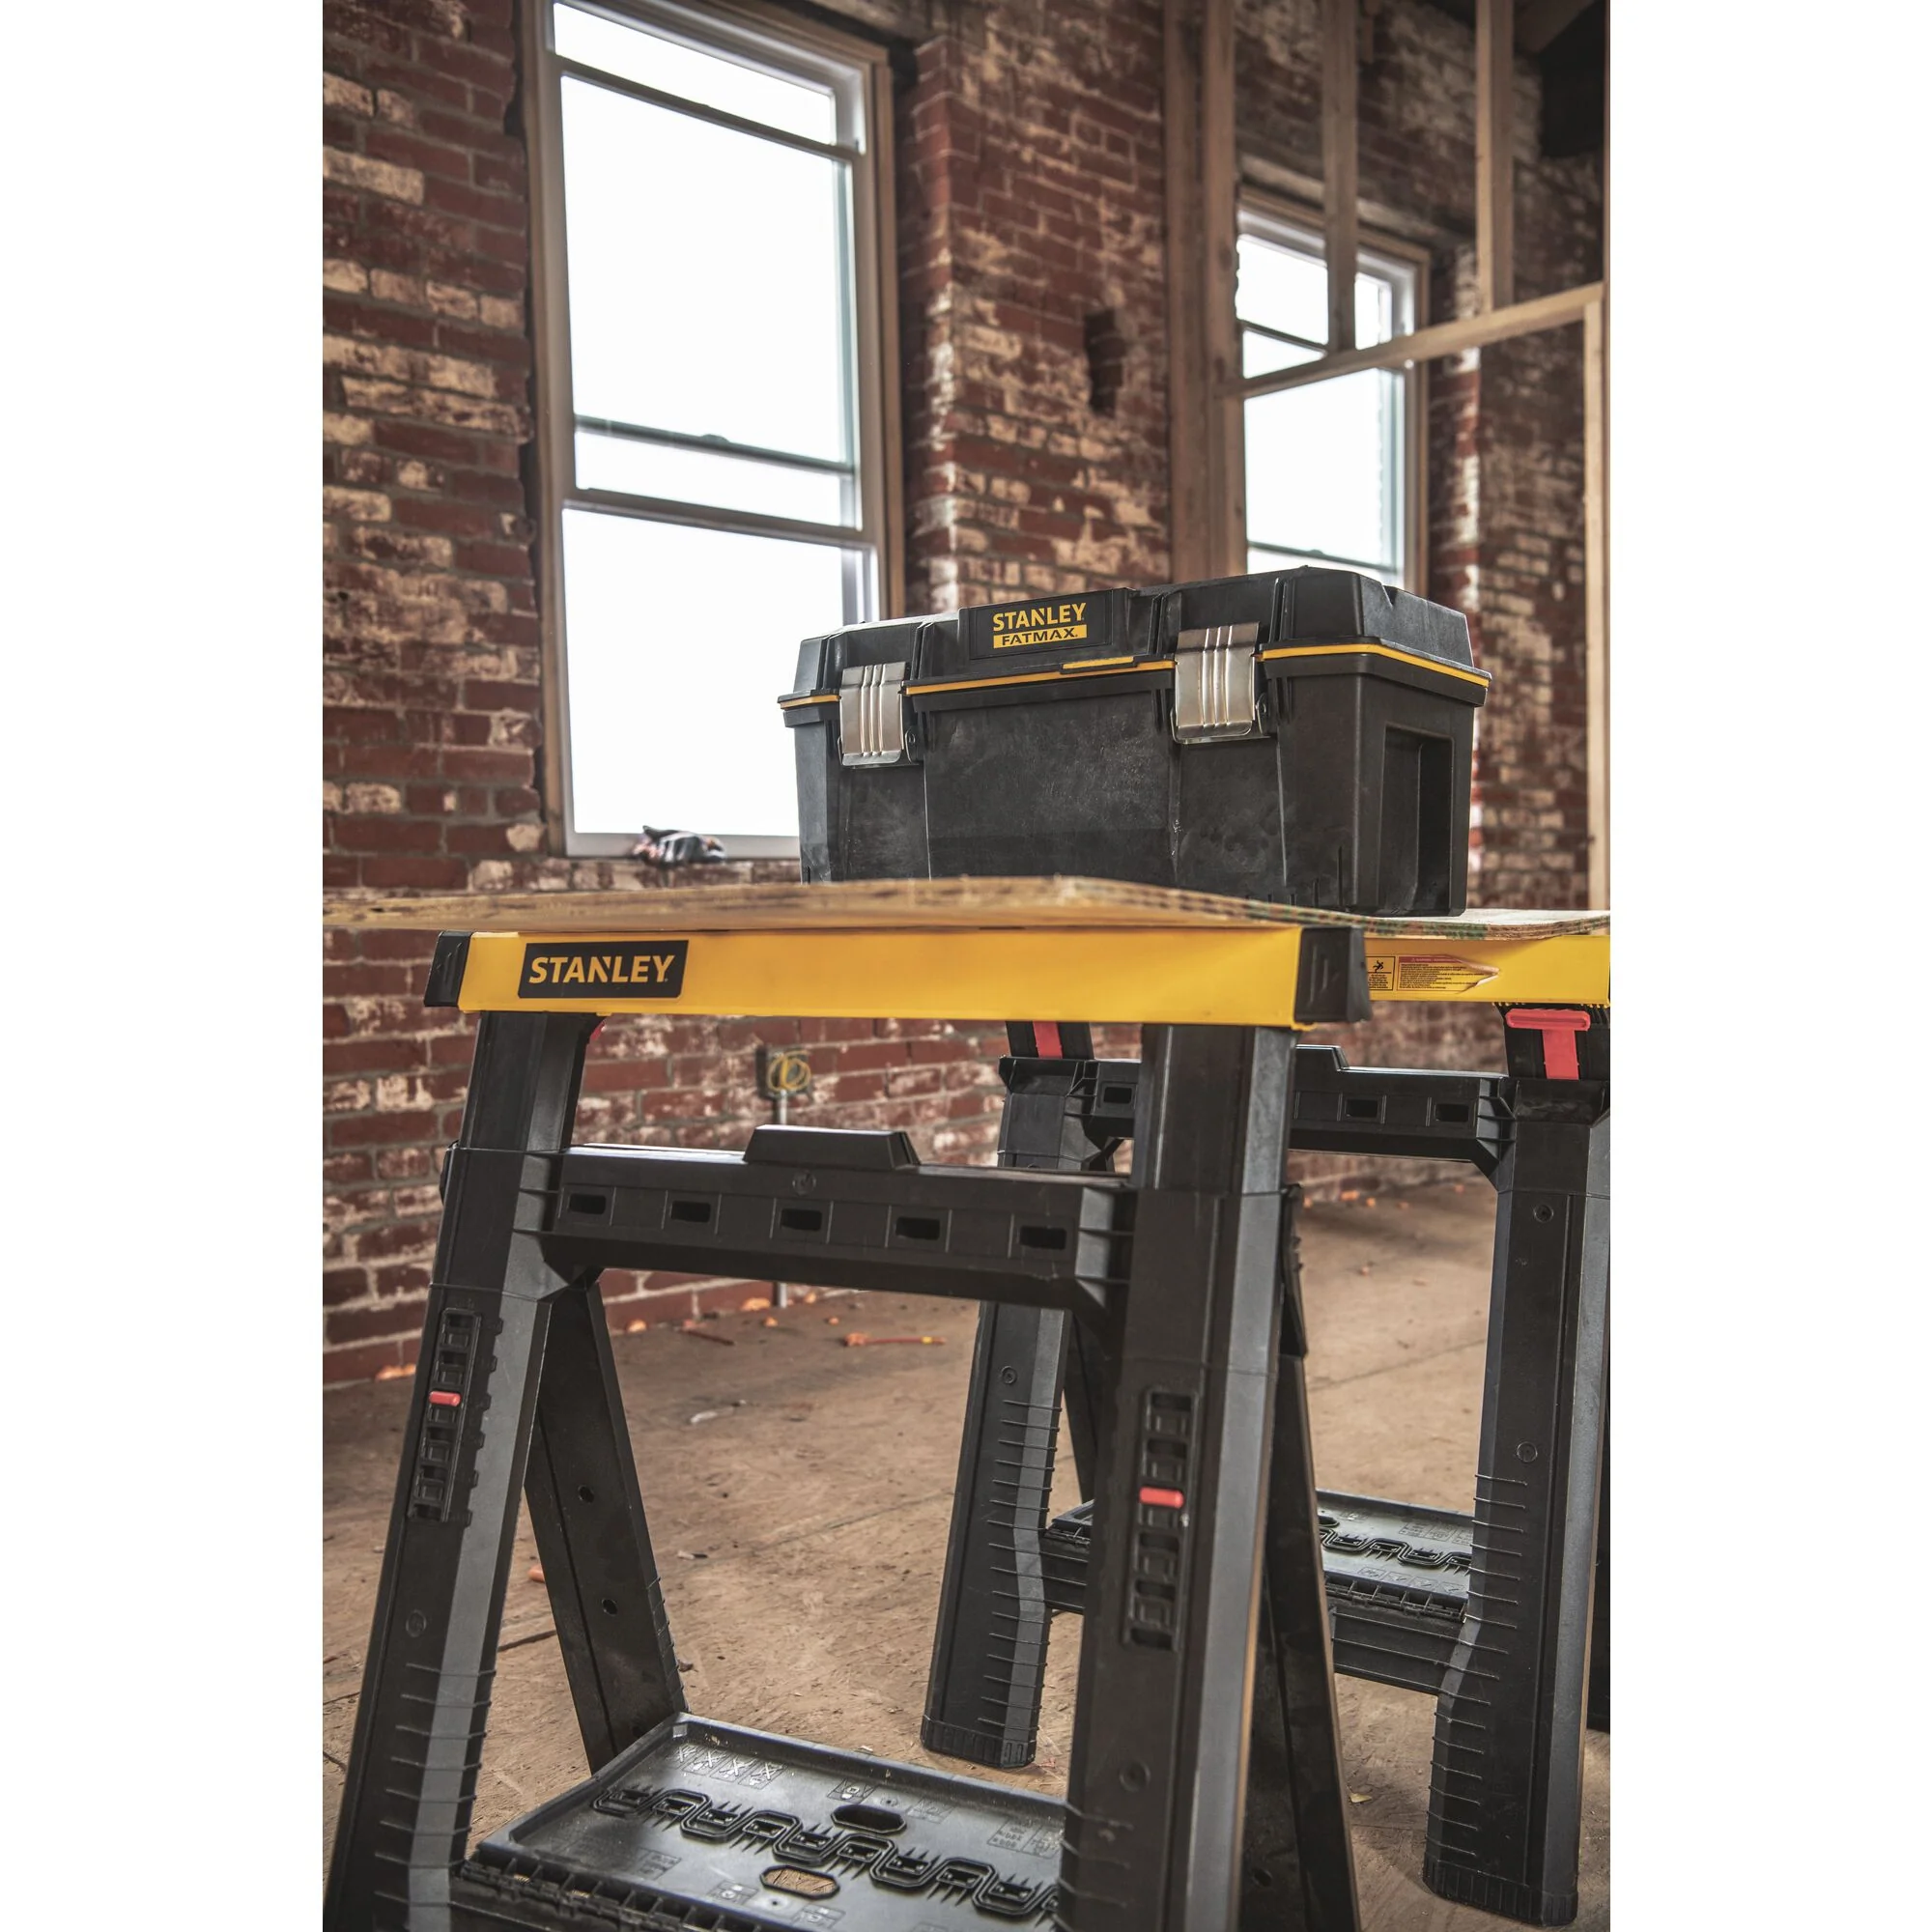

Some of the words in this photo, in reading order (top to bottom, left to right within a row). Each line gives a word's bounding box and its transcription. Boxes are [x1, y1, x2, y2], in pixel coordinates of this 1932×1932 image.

[992, 603, 1087, 632] STANLEY
[1002, 628, 1076, 645] FATMAX
[528, 955, 675, 983] STANLEY
